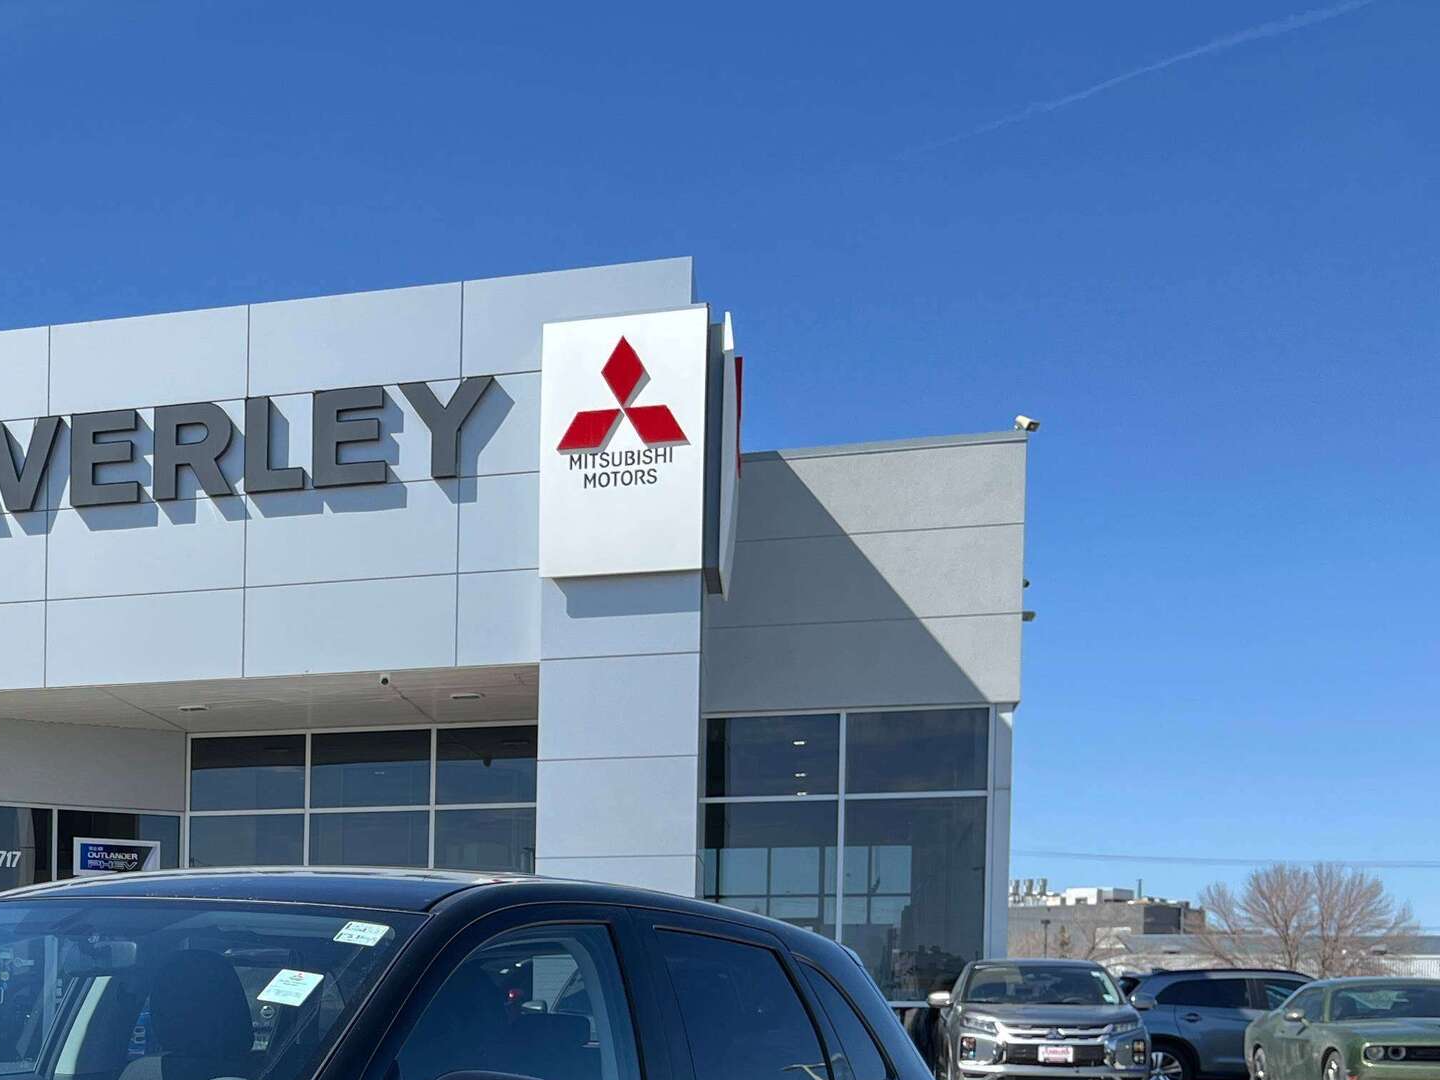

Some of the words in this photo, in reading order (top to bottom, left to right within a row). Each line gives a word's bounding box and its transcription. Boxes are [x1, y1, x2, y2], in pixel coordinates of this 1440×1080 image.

[569, 446, 673, 471] MITSUBISHI
[583, 468, 658, 489] MOTORS
[87, 851, 138, 861] OUTLANDER
